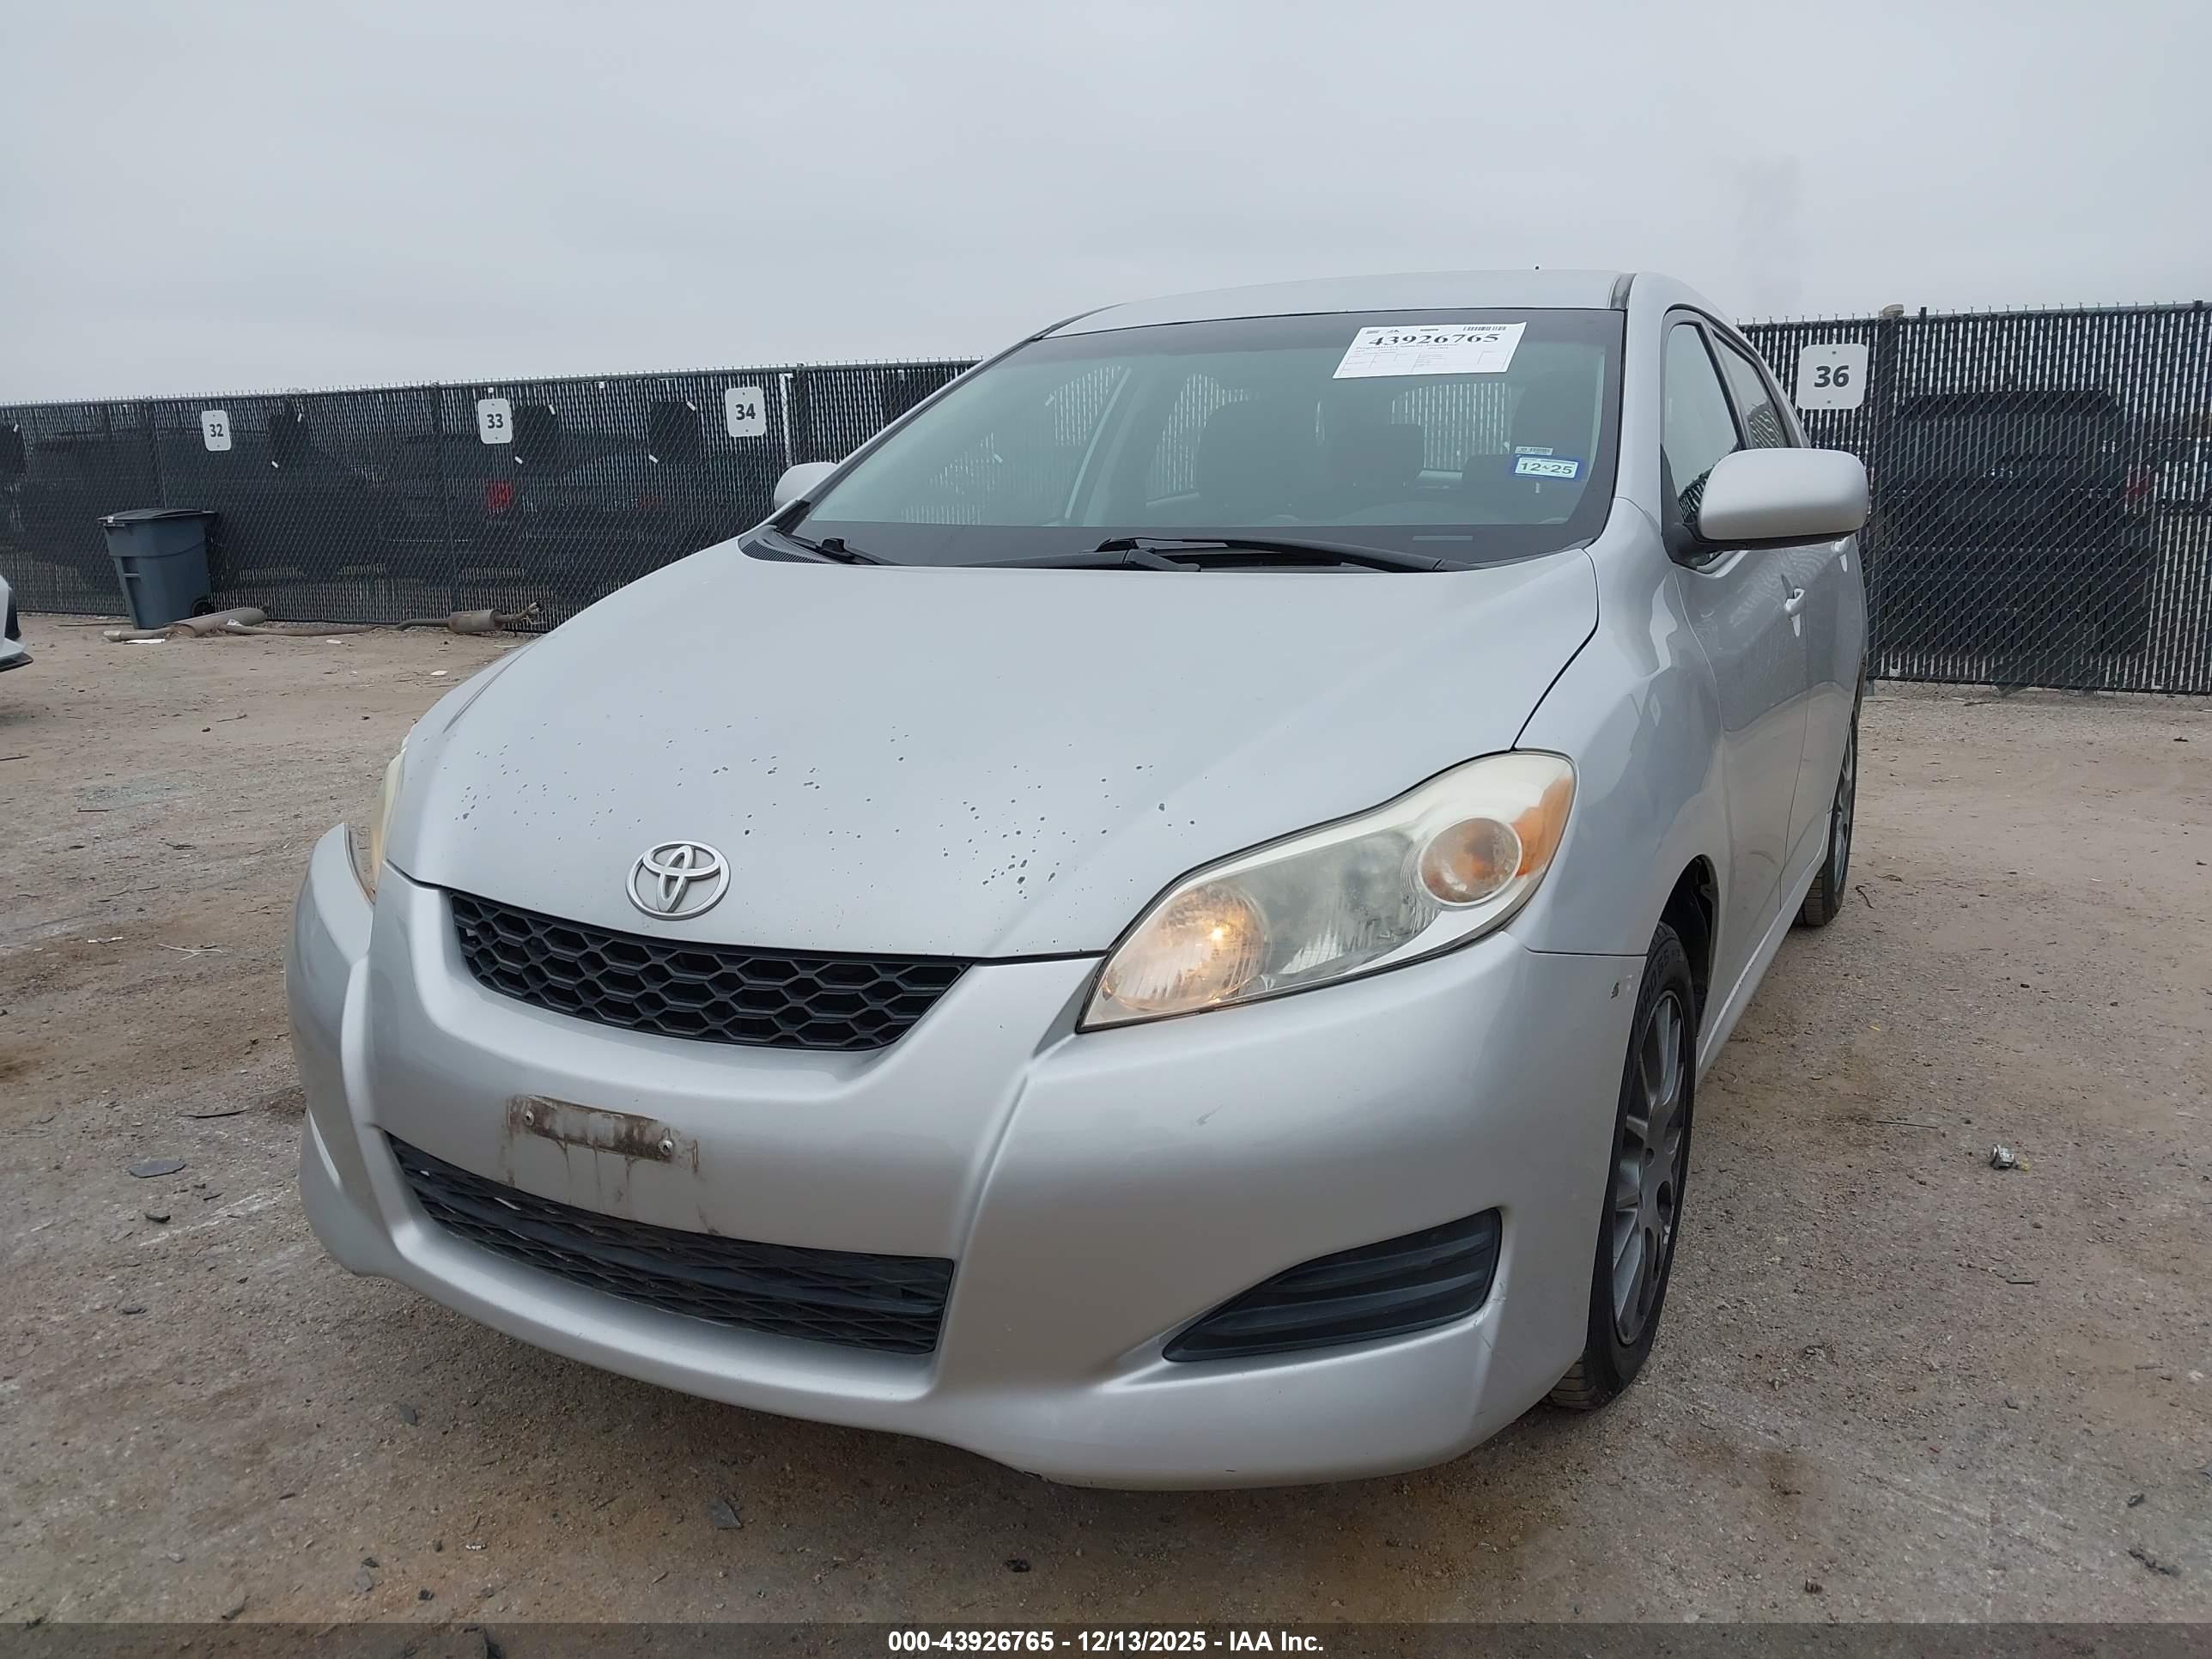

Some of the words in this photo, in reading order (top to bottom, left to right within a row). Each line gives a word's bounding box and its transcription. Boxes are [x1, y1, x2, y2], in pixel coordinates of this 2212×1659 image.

[1368, 333, 1501, 346] 43926765
[1814, 365, 1850, 388] 36
[735, 403, 757, 421] 34
[486, 413, 504, 429] 33
[209, 422, 224, 438] 32
